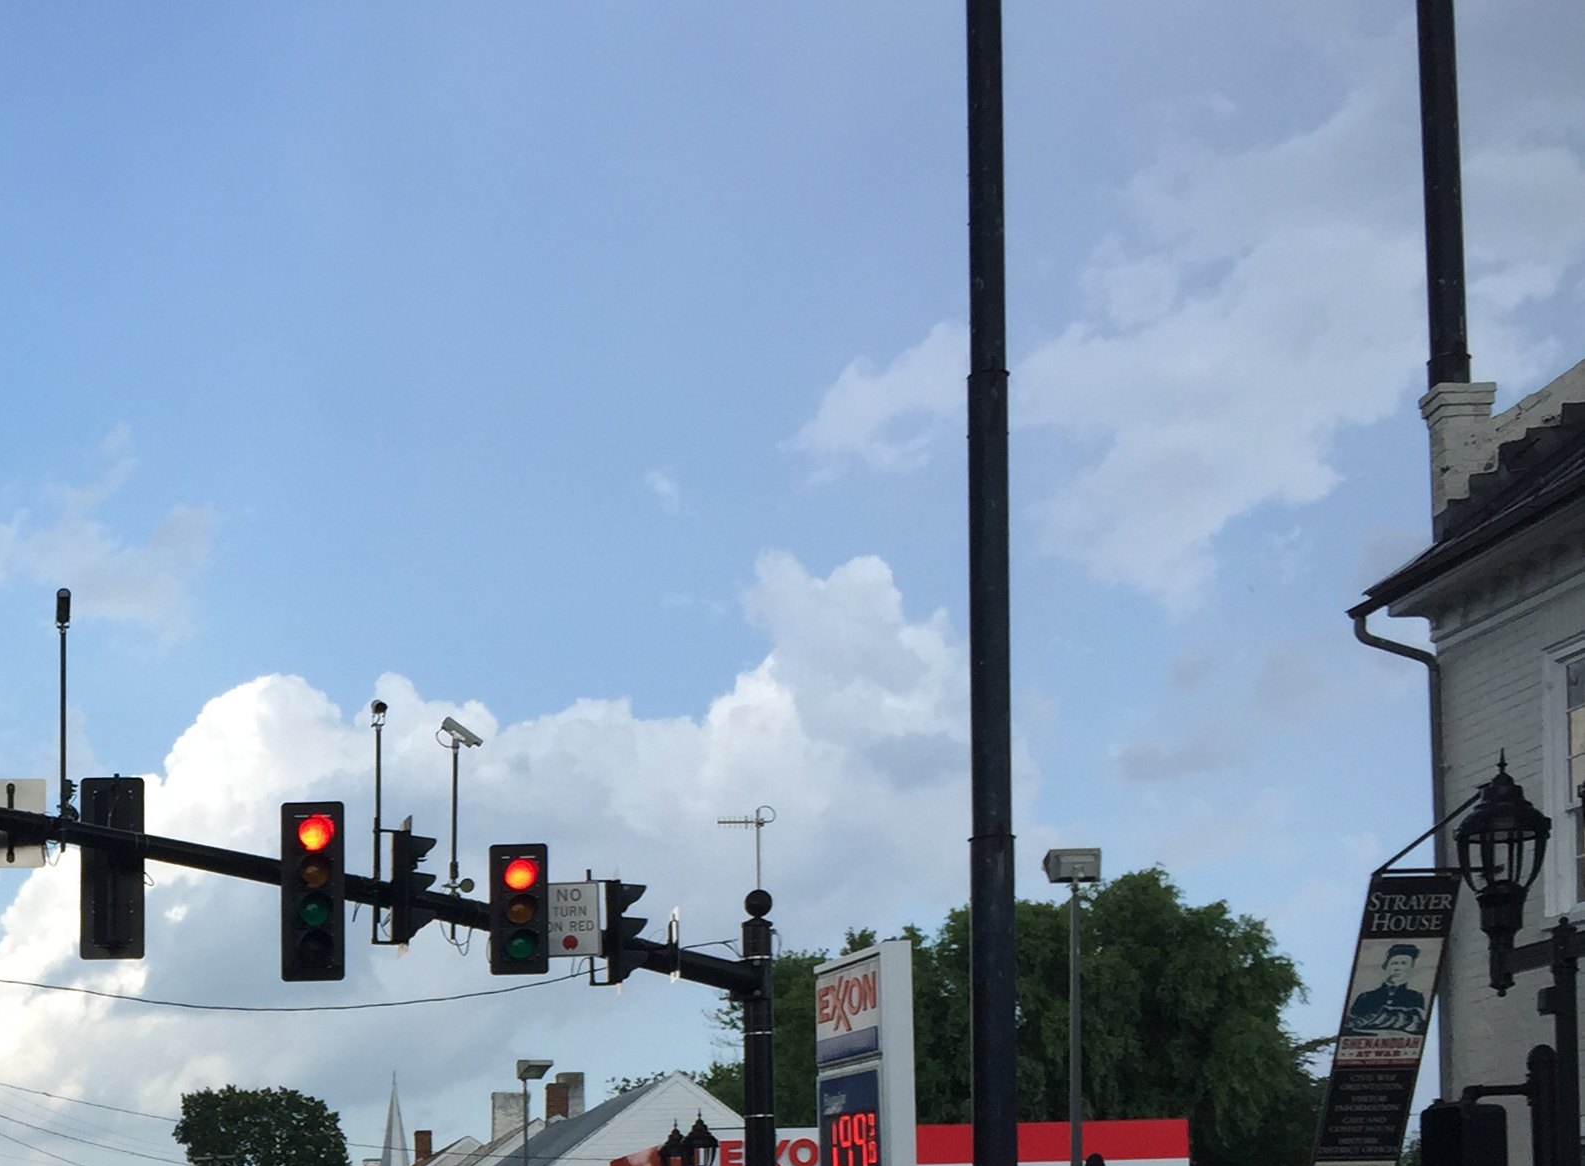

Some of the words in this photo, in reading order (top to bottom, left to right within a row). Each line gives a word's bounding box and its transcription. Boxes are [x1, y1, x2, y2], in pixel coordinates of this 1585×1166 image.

[557, 888, 582, 902] NO
[1368, 892, 1452, 912] STRAYER
[553, 906, 587, 917] TURN
[569, 920, 595, 932] RED
[1371, 913, 1443, 933] HOUSE
[816, 971, 877, 1032] EXXON
[1356, 1050, 1371, 1058] AT
[1374, 1050, 1401, 1058] WAR
